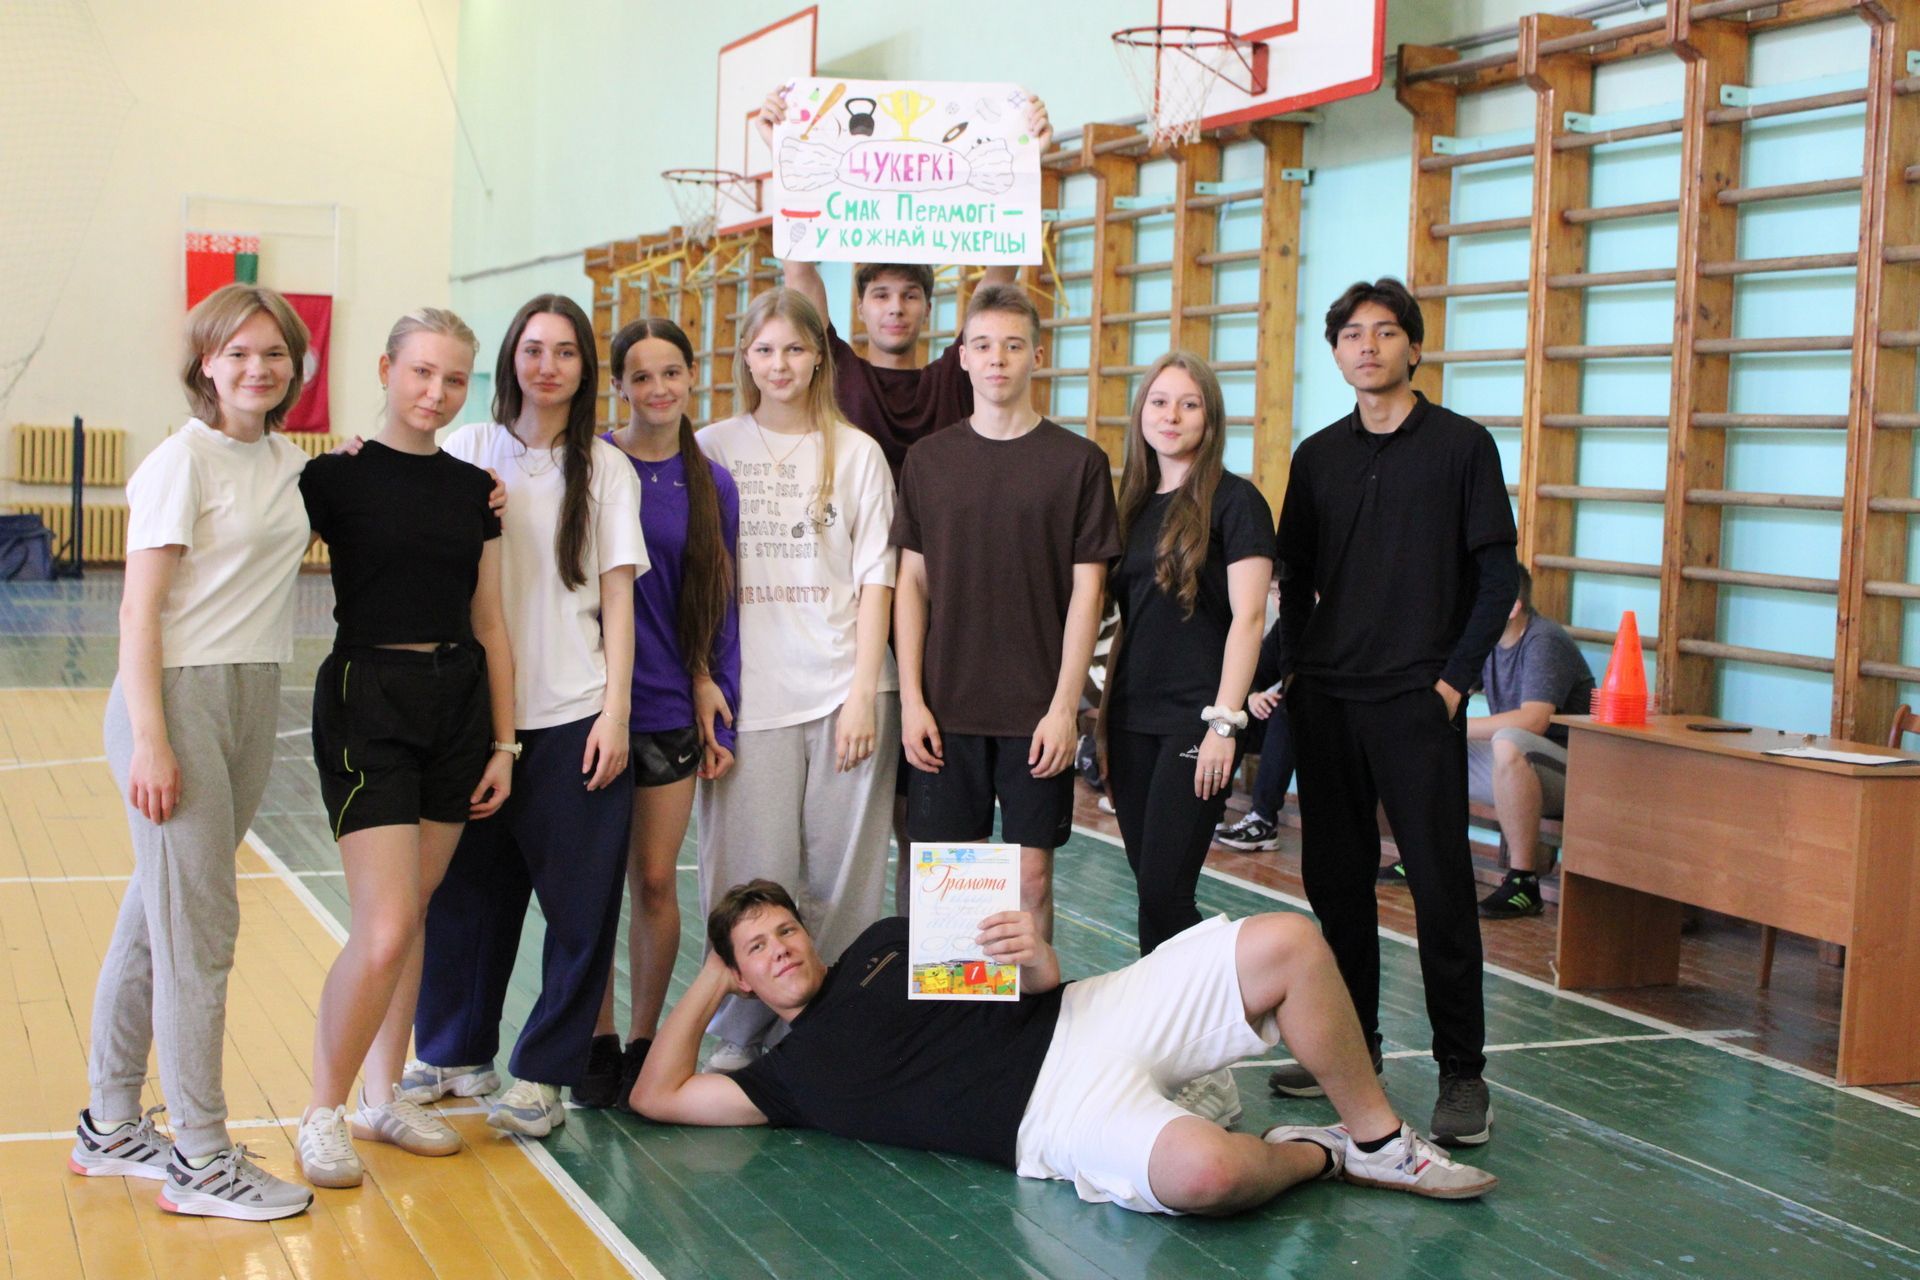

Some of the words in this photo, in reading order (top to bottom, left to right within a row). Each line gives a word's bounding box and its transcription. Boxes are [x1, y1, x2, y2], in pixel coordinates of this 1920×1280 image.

[732, 460, 772, 477] JUST
[737, 480, 803, 498] MIL-ISH,
[740, 498, 781, 516] OU'LL
[740, 520, 788, 536] LWAYS
[922, 864, 1007, 901] Грамота
